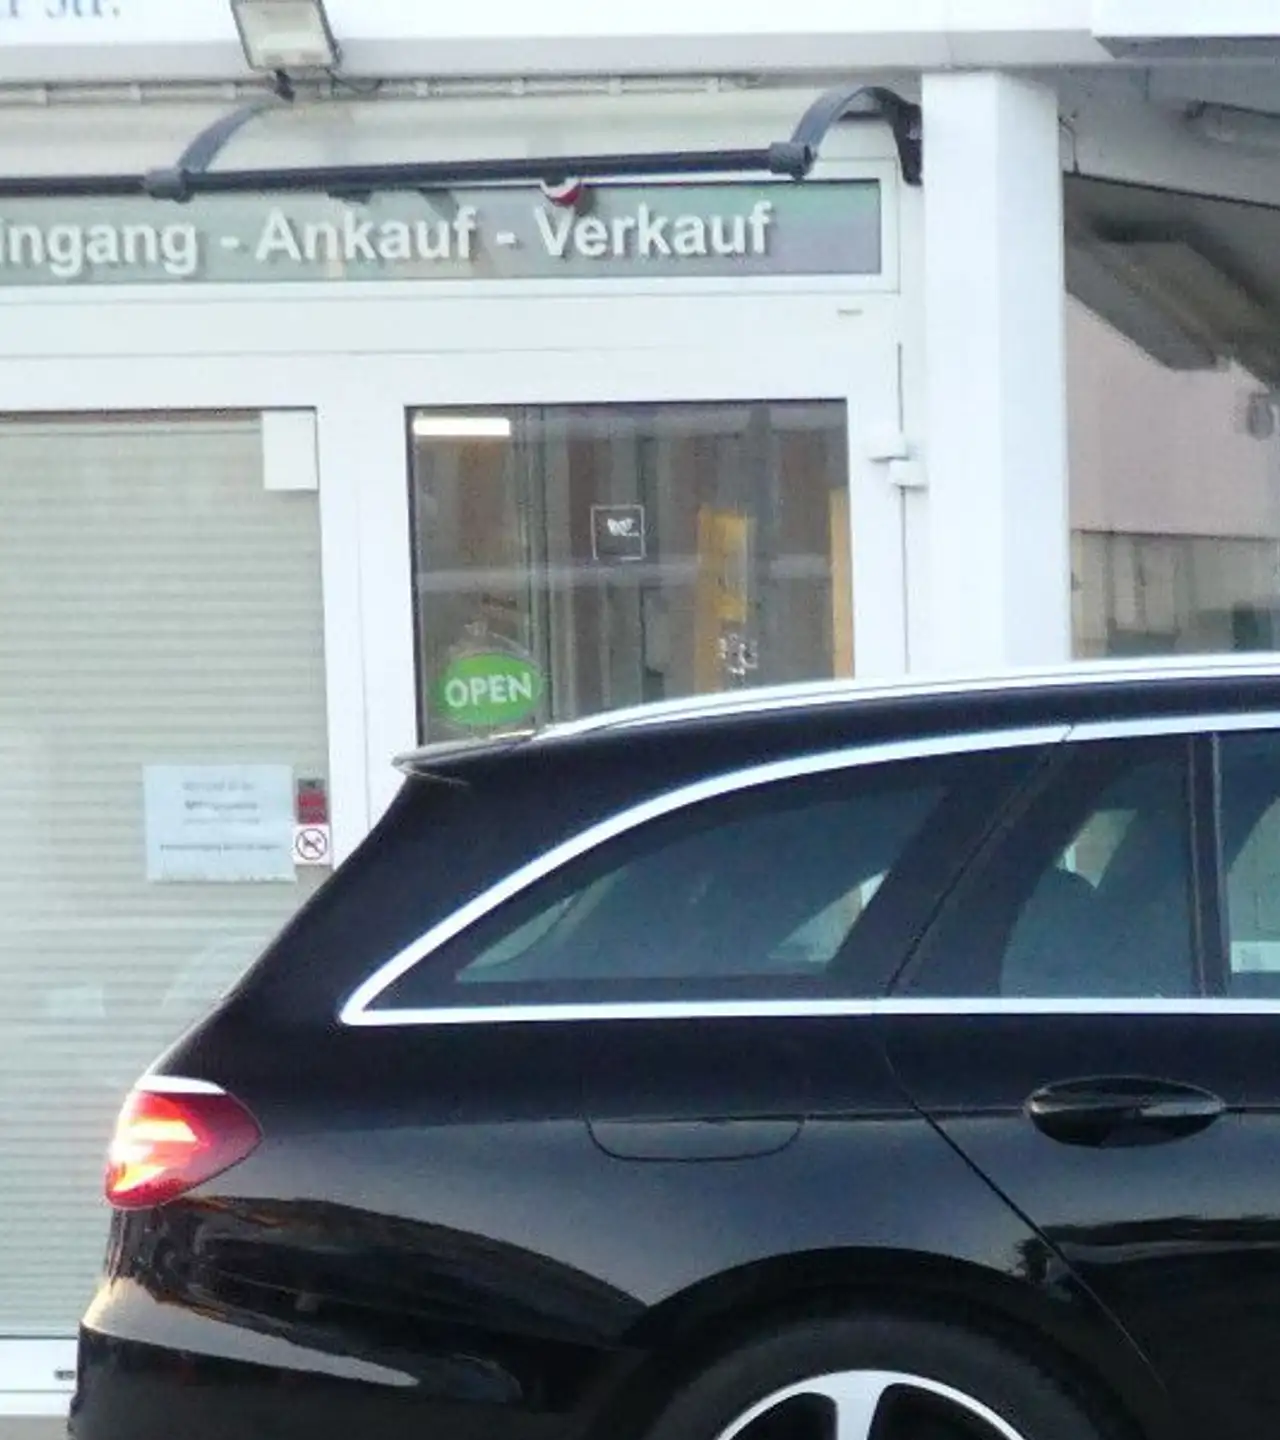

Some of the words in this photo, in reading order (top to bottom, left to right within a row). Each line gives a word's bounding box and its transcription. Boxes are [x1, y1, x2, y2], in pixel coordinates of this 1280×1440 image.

[255, 205, 477, 261] Ankauf
[533, 199, 773, 257] Verkauf
[444, 671, 532, 708] OPEN
